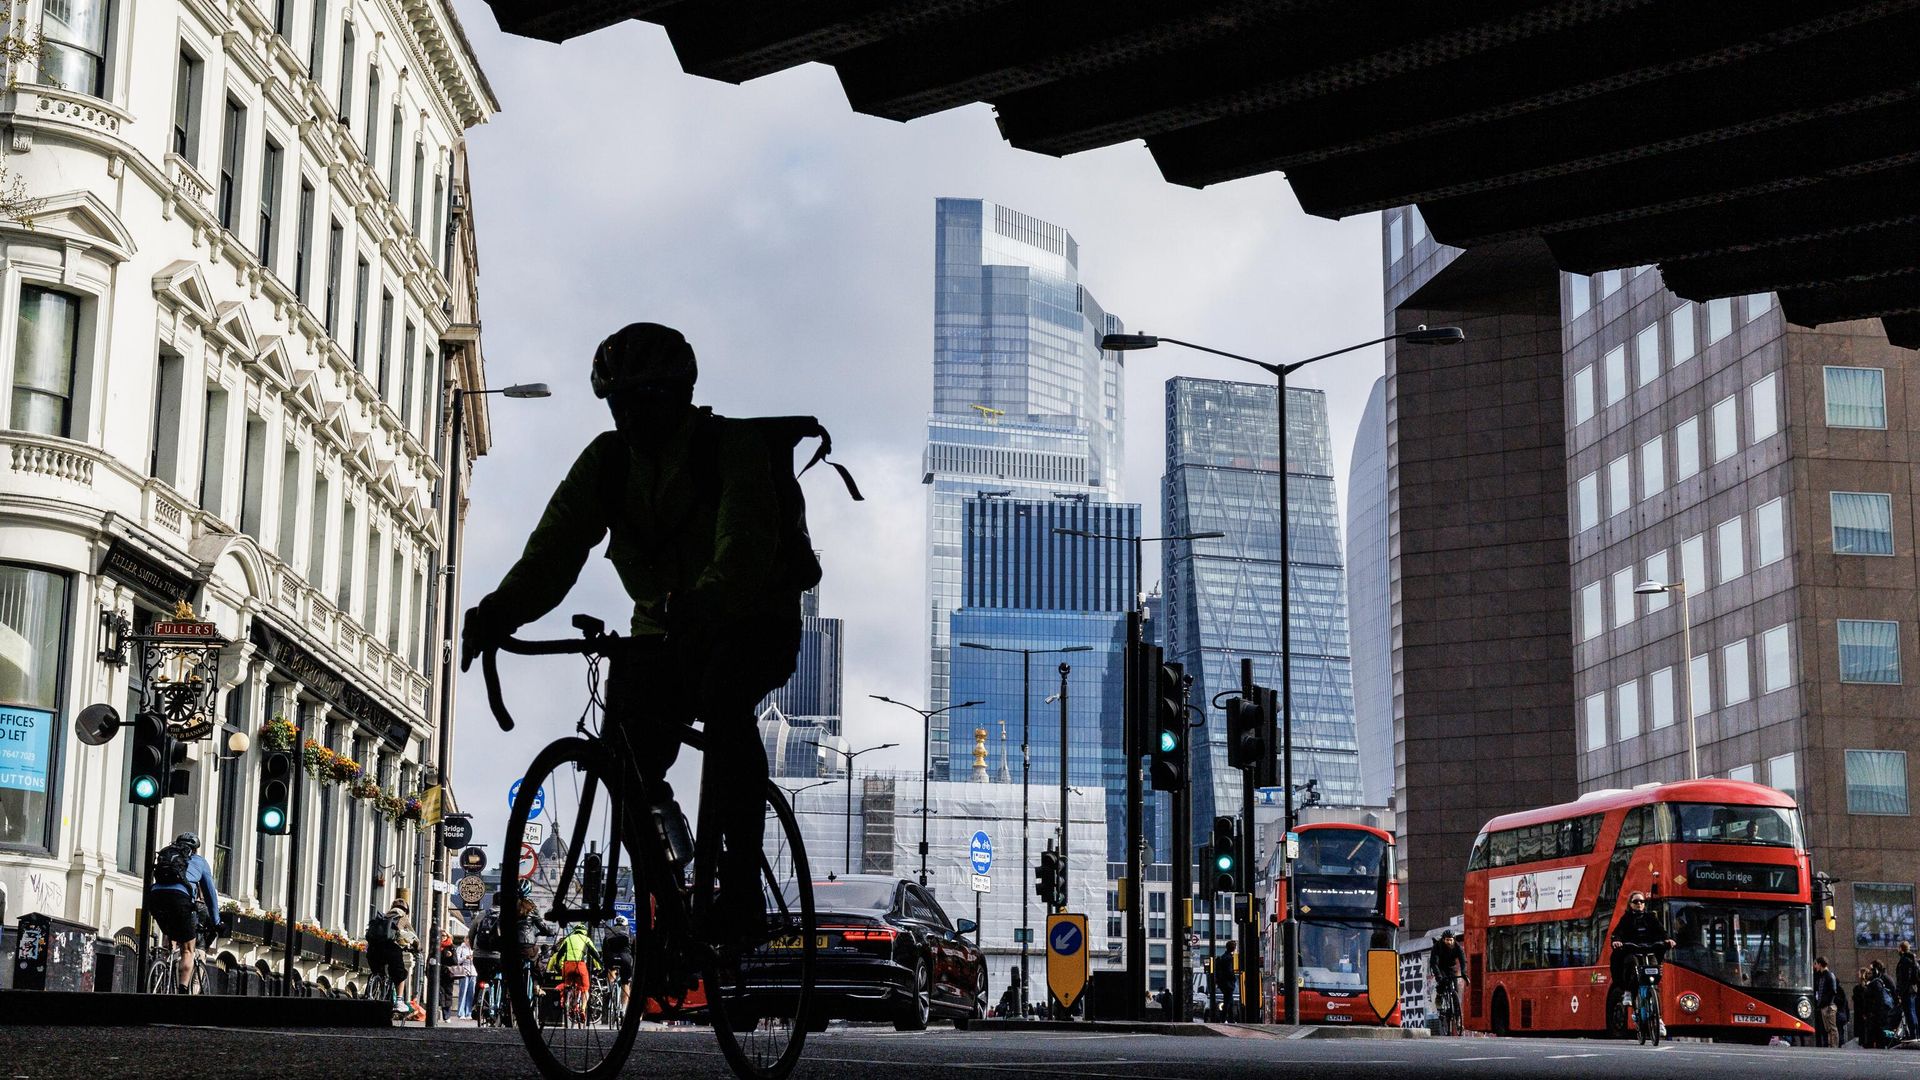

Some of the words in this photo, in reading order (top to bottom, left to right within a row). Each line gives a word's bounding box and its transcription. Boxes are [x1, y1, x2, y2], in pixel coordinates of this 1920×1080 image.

[157, 623, 210, 635] FULLER'S
[8, 729, 27, 742] LET
[1695, 869, 1725, 880] London
[1727, 871, 1753, 884] Bridge
[1769, 871, 1785, 888] 17
